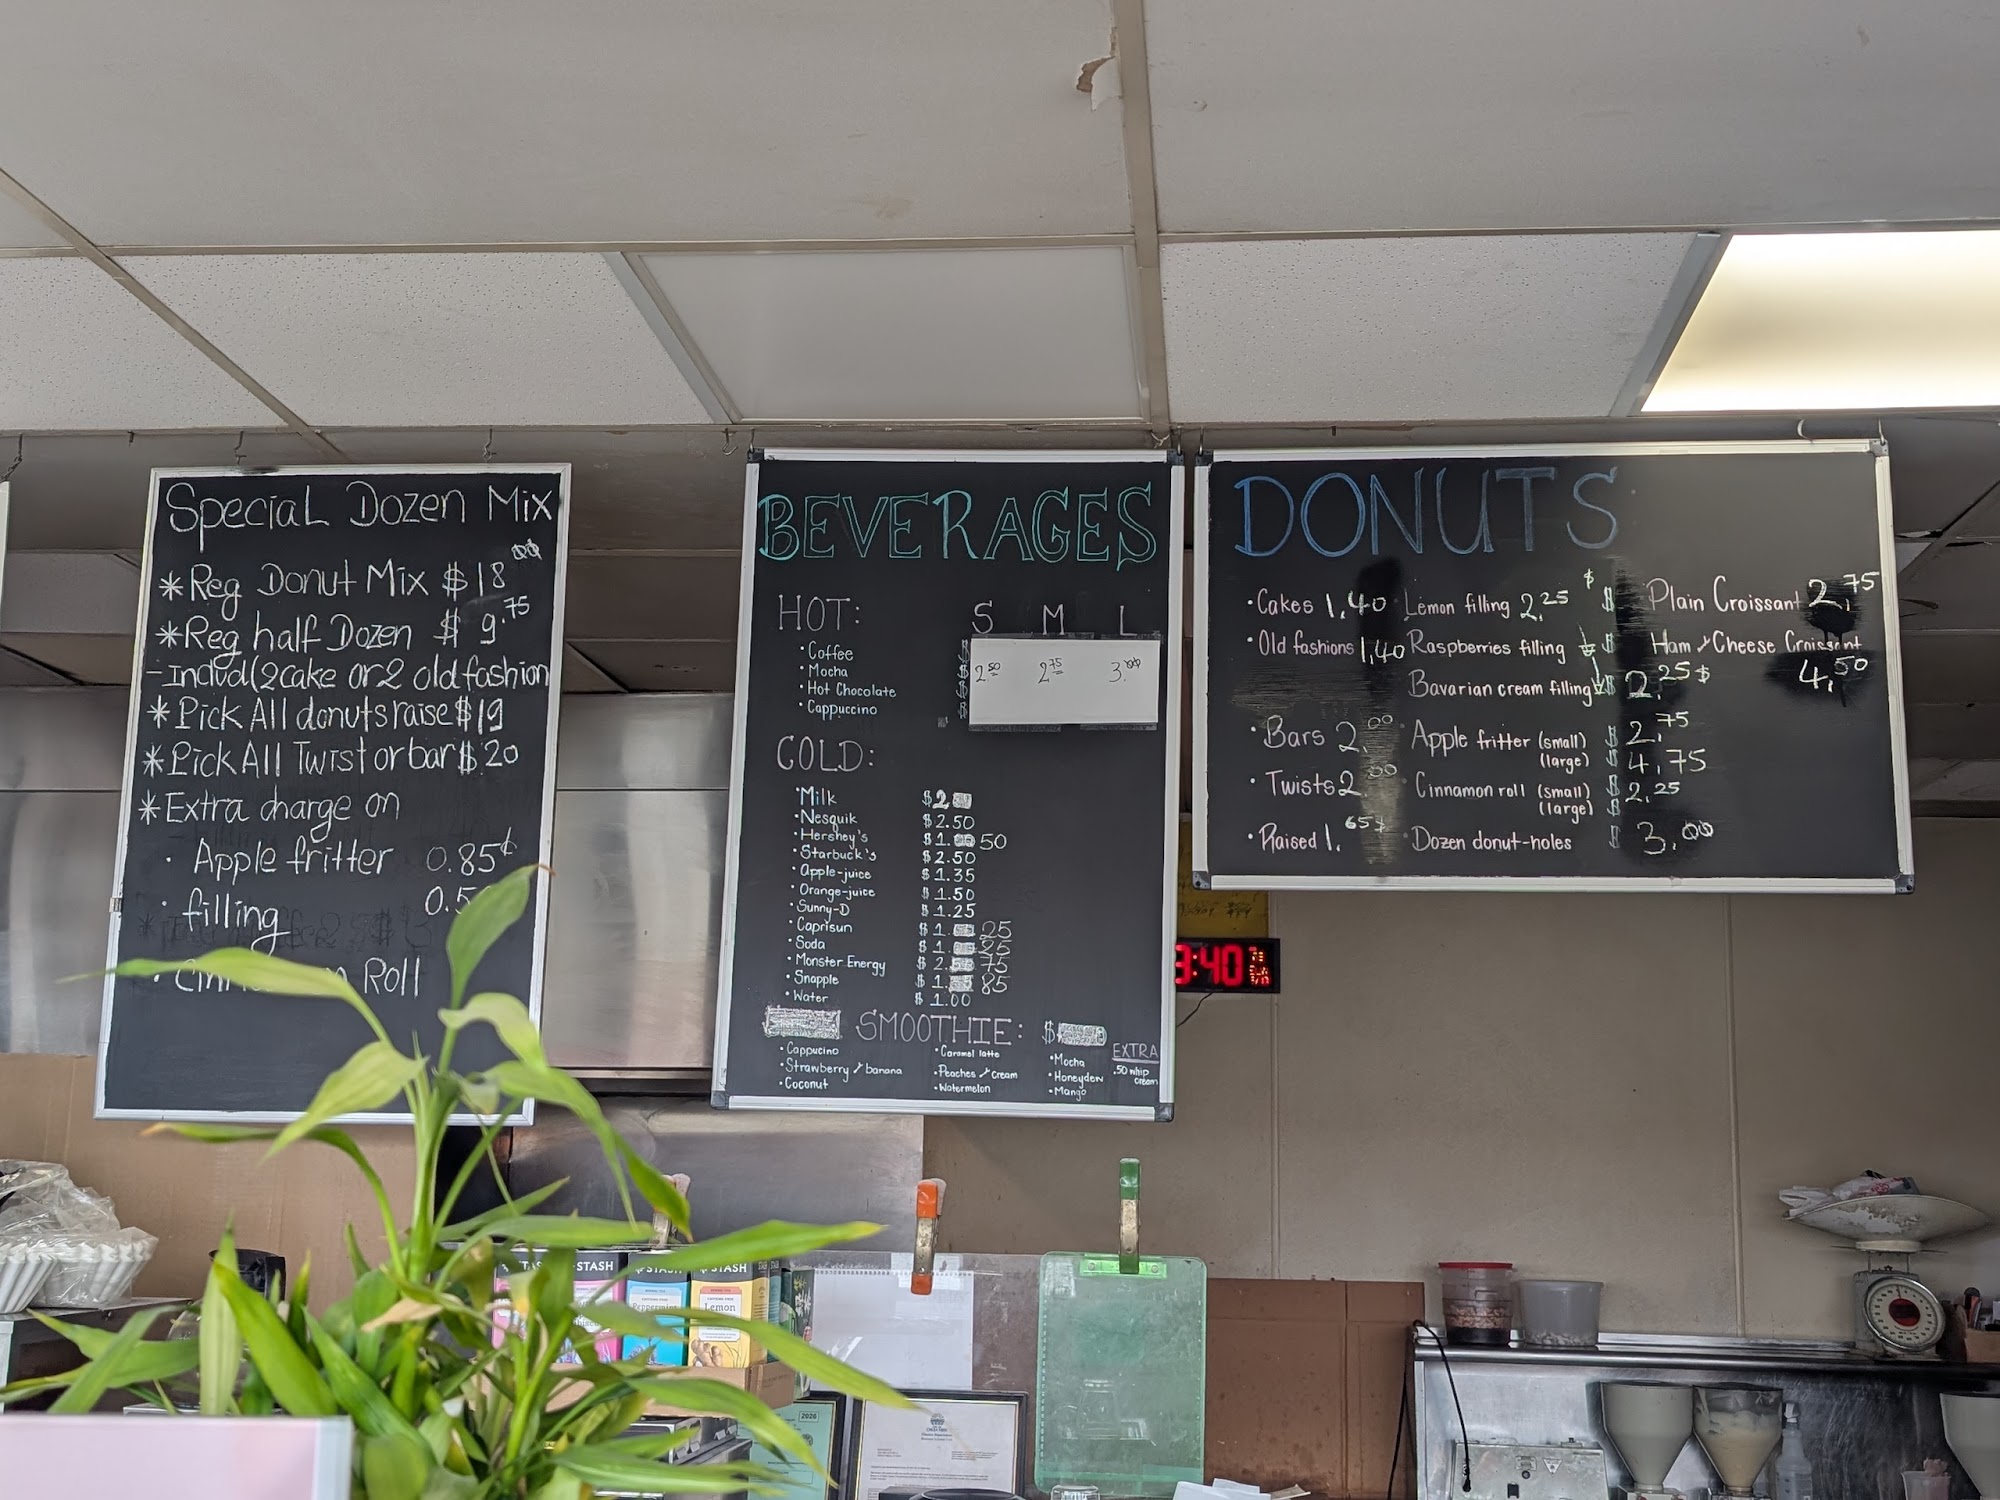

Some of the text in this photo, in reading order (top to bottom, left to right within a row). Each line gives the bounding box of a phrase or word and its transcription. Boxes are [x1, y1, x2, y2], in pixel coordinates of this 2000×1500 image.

[346, 480, 466, 527] Dozen
[489, 485, 553, 523] Mix
[1234, 467, 1620, 557] DONUTS
[758, 481, 1157, 572] BEVERAGES
[190, 563, 243, 621] Reg
[257, 559, 357, 596] Donut
[367, 558, 429, 597] Mix
[1257, 588, 1314, 614] Cakes
[1646, 578, 1704, 611] Plain
[1713, 575, 1799, 615] Croissant
[778, 594, 1138, 636] HOT: S M L
[1404, 589, 1455, 616] Lemon
[1466, 594, 1511, 620] filling
[185, 614, 243, 670] Reg
[253, 609, 321, 653] half
[326, 613, 412, 652] Dozen
[1259, 629, 1286, 656] Old
[1293, 629, 1354, 656] fashions
[1407, 629, 1511, 656] Raspberries
[1519, 637, 1565, 664] filling
[1650, 629, 1691, 655] Ham
[1711, 630, 1776, 654] Cheese
[808, 641, 854, 662] Coffee
[462, 654, 549, 691] fashion
[808, 665, 849, 678] Mocha
[807, 683, 830, 697] Hot
[836, 685, 897, 699] Chocolate
[1408, 669, 1492, 698] Bavarian
[1498, 683, 1543, 697] cream
[1549, 680, 1592, 707] filling
[175, 696, 243, 730] Pick
[250, 697, 286, 732] All
[296, 696, 387, 732] donuts
[393, 700, 453, 729] raise
[807, 703, 878, 720] Cappuccino
[1263, 715, 1325, 748] Bars
[1411, 719, 1468, 757] Apple
[1477, 729, 1531, 750] fritter
[1538, 731, 1587, 749] (small)
[167, 741, 237, 777] Pick
[242, 740, 280, 778] All
[293, 737, 367, 774] Twist
[374, 746, 405, 771] or
[409, 737, 456, 769] bar
[777, 735, 874, 772] COLD:
[1540, 752, 1590, 774] (large)
[1265, 770, 1335, 796] Twists
[1416, 771, 1493, 798] Cinnamon
[1499, 784, 1525, 798] roll
[1538, 782, 1590, 800] (small)
[799, 786, 837, 806] Milk
[165, 784, 400, 844] Extra charge on
[800, 810, 858, 833] Nesquik
[1539, 800, 1594, 824] (large)
[800, 829, 1007, 850] Hershey's 50
[1259, 822, 1317, 854] Raised
[1411, 826, 1466, 851] Dozen
[1472, 830, 1572, 851] donut-holes
[194, 839, 278, 885] Apple
[286, 836, 394, 875] fritter
[800, 847, 877, 861] Starbuck's
[799, 864, 872, 883] Apple-juice
[799, 883, 876, 903] Orange-juice
[182, 888, 291, 957] filling
[797, 900, 850, 922] Sunny-D
[797, 918, 853, 934] Caprisun
[795, 937, 825, 950] Soda
[364, 956, 420, 997] Roll
[795, 955, 844, 969] Monster
[847, 956, 886, 977] Energy
[794, 972, 840, 986] Snapple
[793, 990, 829, 1003] Water
[856, 1009, 1022, 1046] SMOOTHIE:
[787, 1041, 839, 1057] Cappucino
[979, 1049, 1000, 1058] latte
[1054, 1053, 1085, 1068] Mocha
[1113, 1043, 1158, 1058] EXTRA
[785, 1057, 902, 1083] Strawberry banana
[938, 1064, 976, 1078] Peaches
[1054, 1070, 1103, 1089] Honeydew
[1129, 1066, 1149, 1077] whip
[1134, 1077, 1158, 1086] cream
[785, 1077, 828, 1090] Coconut
[939, 1083, 991, 1093] Watermelon
[1054, 1086, 1087, 1101] Mango
[576, 1261, 614, 1271] STASH
[704, 1302, 736, 1312] Lemon
